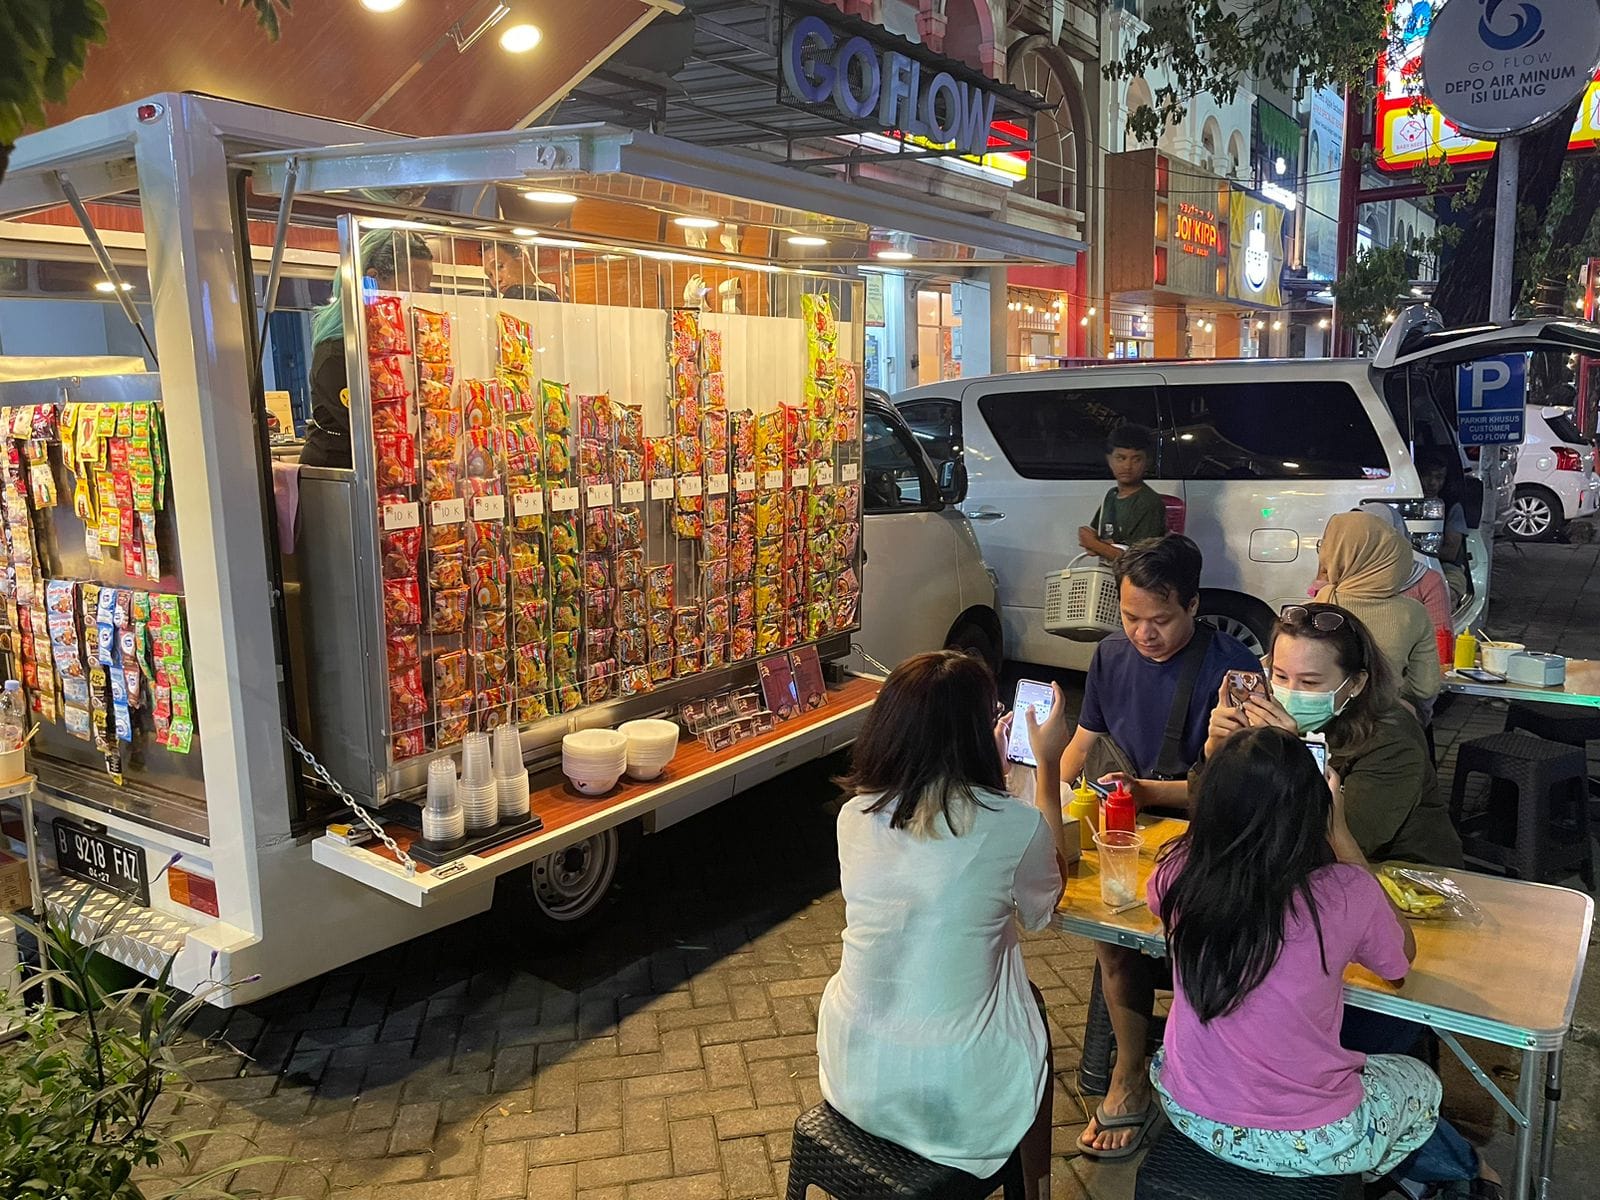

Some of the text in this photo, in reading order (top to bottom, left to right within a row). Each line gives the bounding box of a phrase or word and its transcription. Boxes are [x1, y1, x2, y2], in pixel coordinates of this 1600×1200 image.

[1468, 52, 1552, 73] GO FLOW
[782, 16, 996, 155] GO FLOW
[1445, 65, 1575, 94] DEPO AIR MINUM
[1471, 83, 1546, 104] ISI ULANG
[1472, 360, 1511, 408] P
[1460, 415, 1520, 424] PARKIR KHUSUS
[1469, 424, 1510, 432] CUSTOMER
[1472, 433, 1507, 441] GO FLOW
[394, 511, 403, 521] 10
[58, 827, 139, 883] B 9218 FAZ
